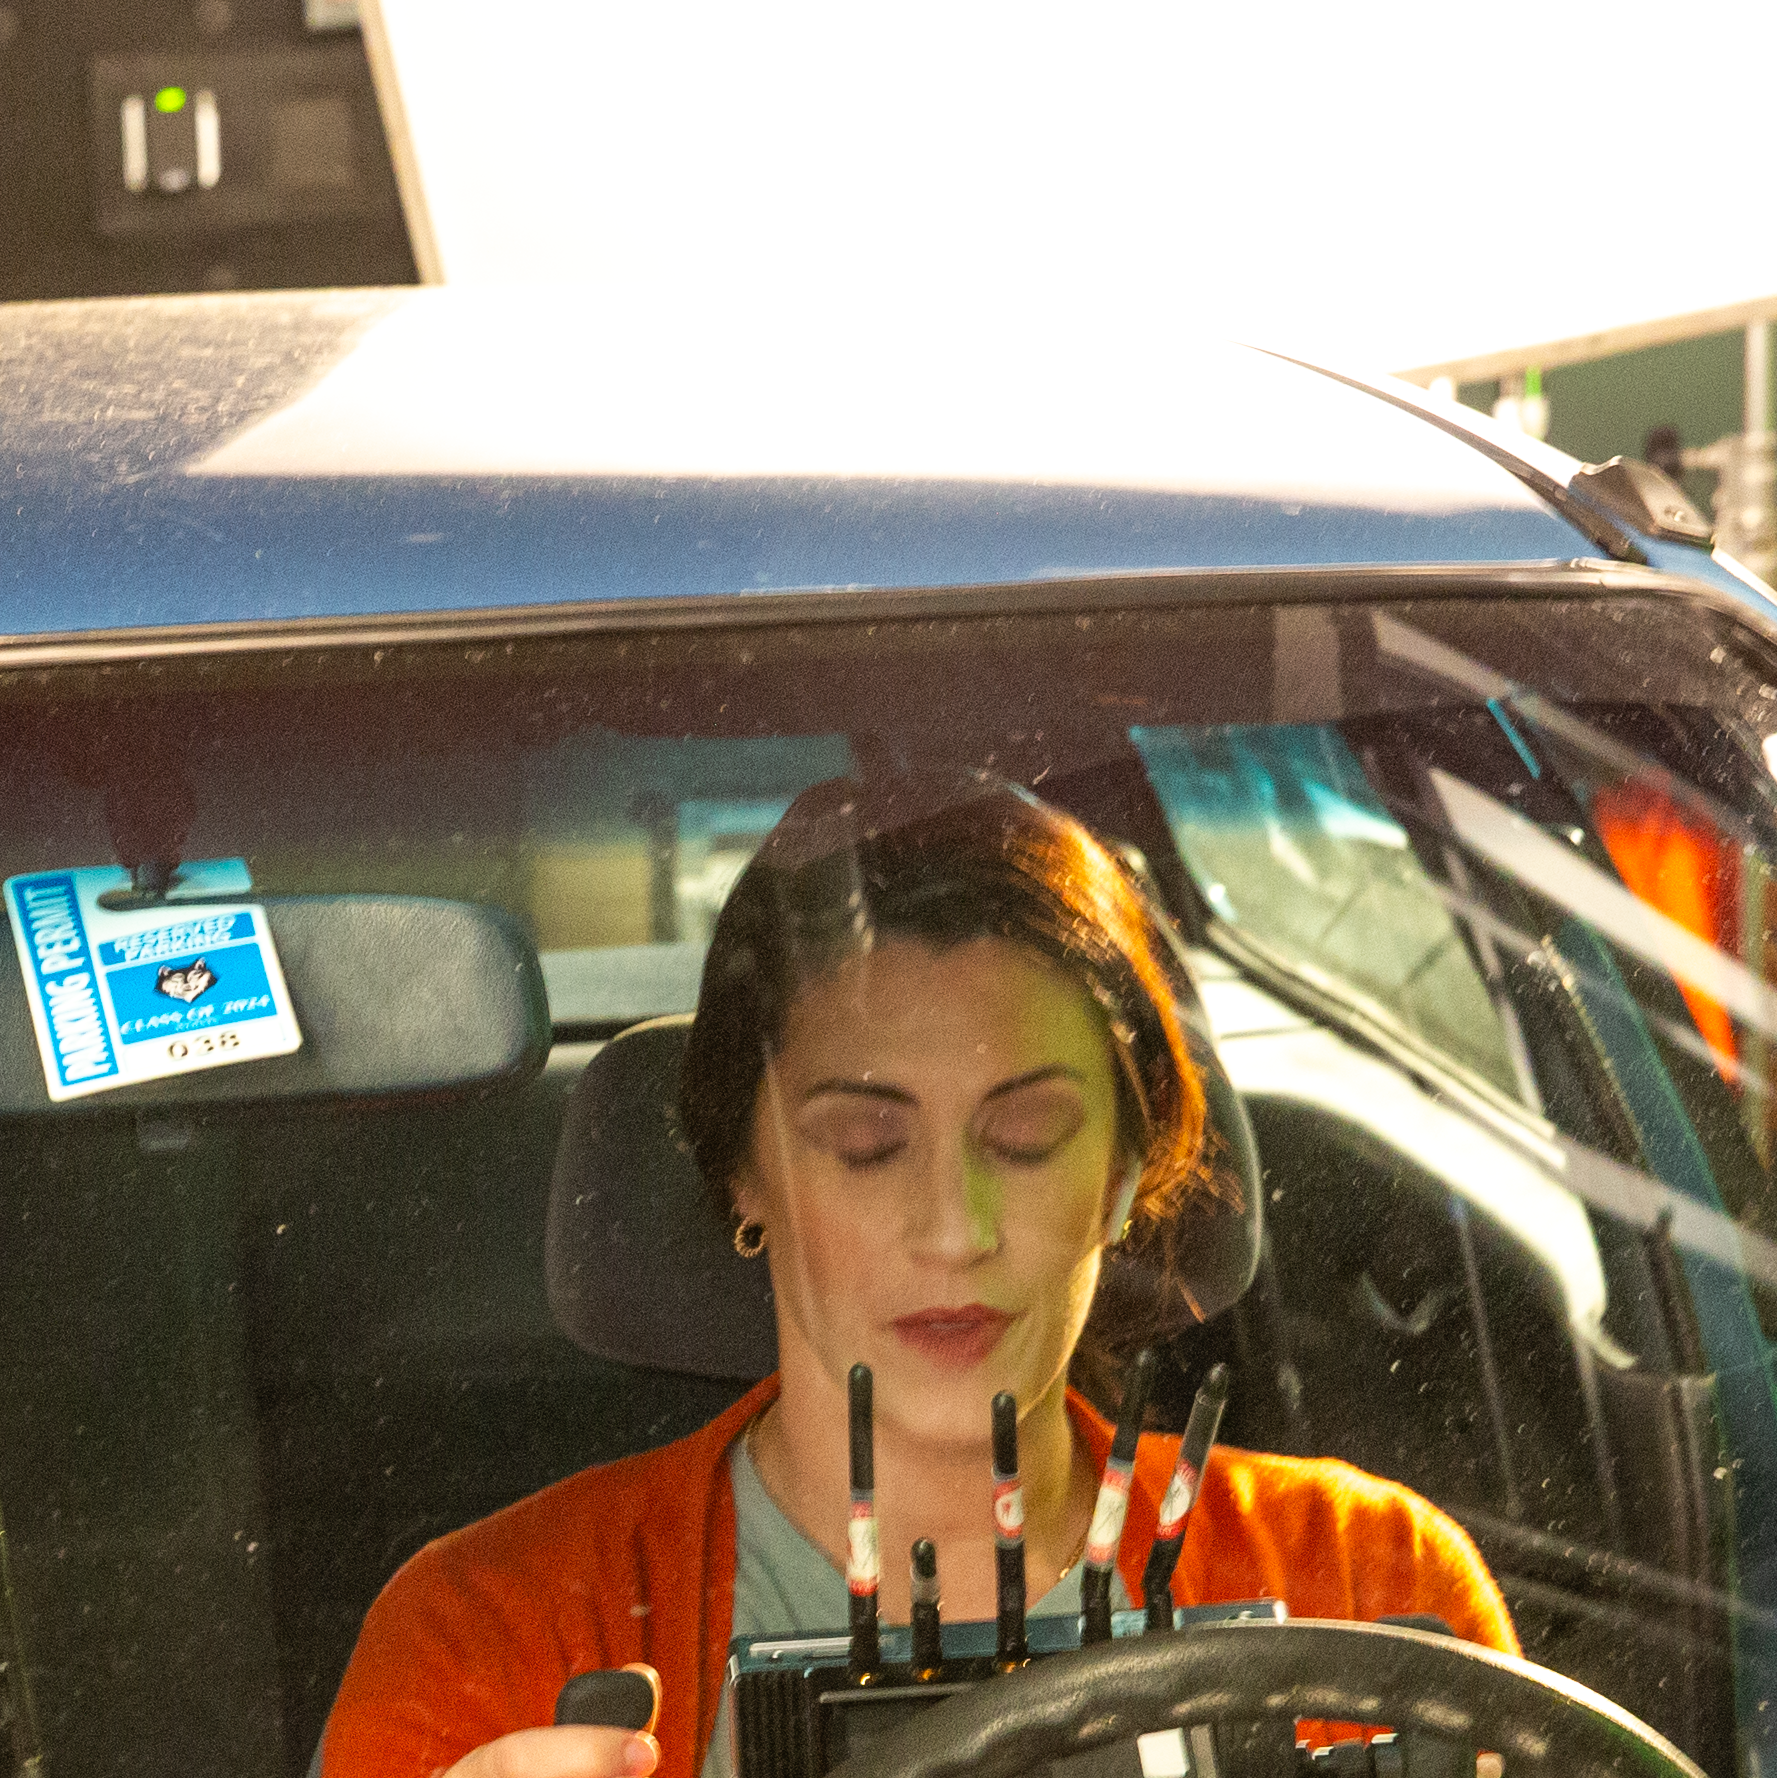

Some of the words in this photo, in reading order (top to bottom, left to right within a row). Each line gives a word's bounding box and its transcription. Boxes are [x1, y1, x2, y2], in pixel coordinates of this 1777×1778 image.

[24, 884, 85, 976] PERMIT
[113, 914, 237, 953] RESERVED
[44, 971, 113, 1083] PARKING
